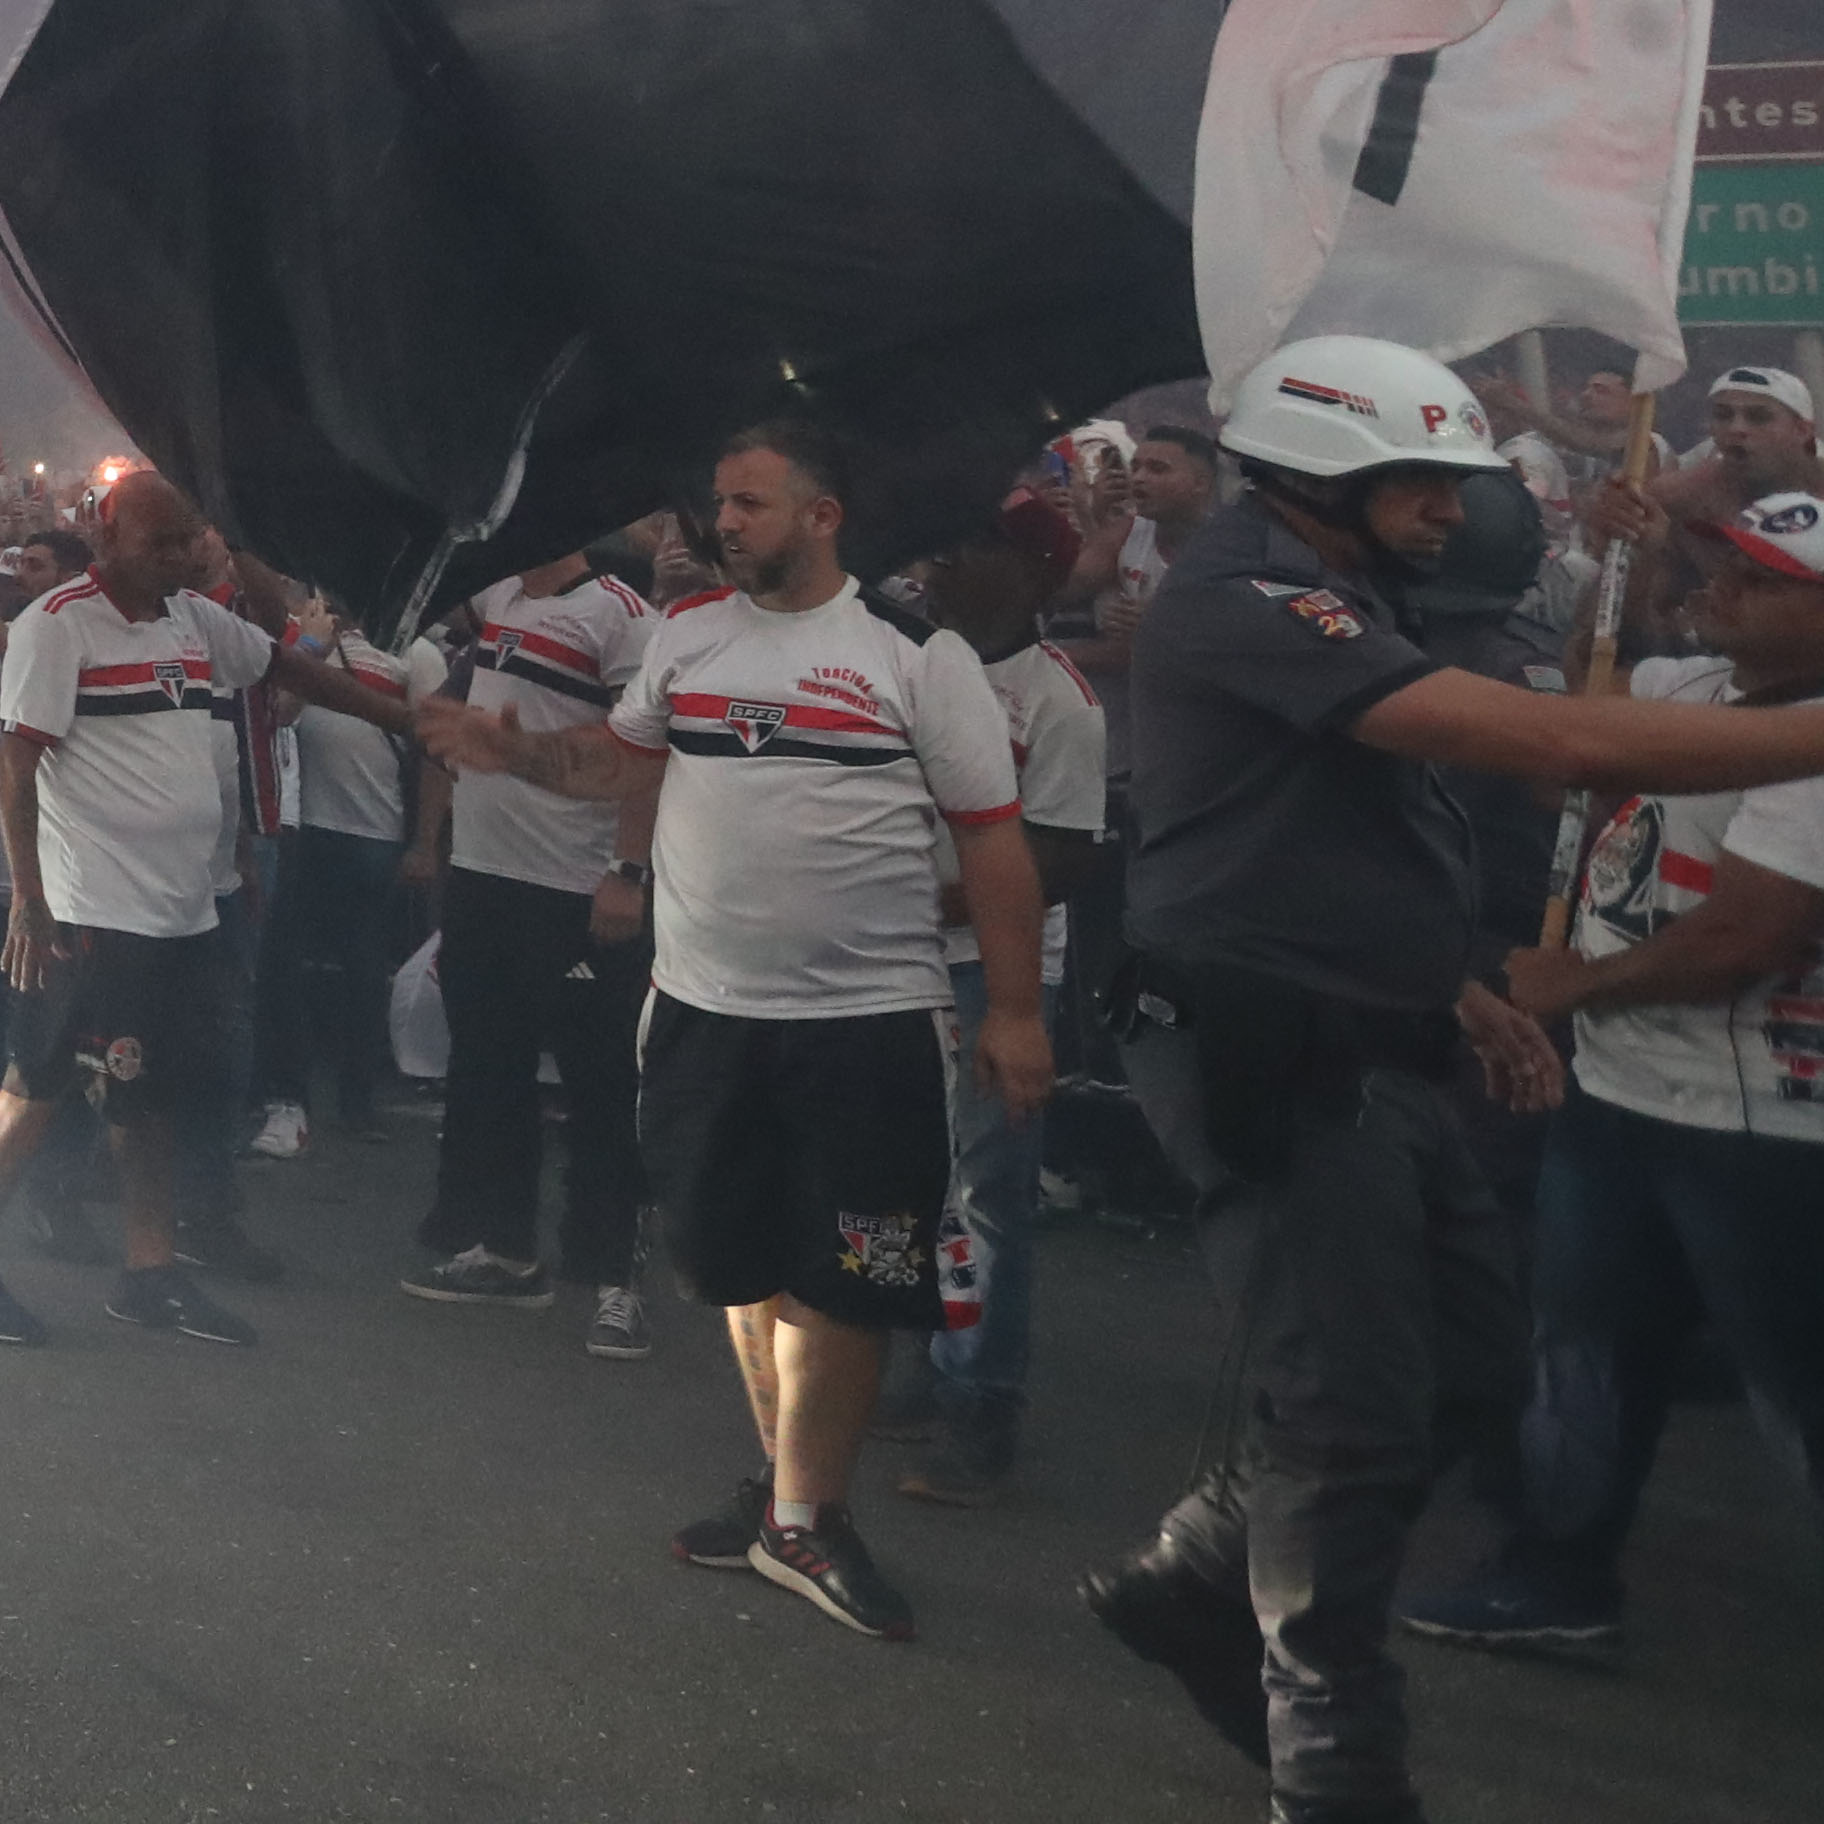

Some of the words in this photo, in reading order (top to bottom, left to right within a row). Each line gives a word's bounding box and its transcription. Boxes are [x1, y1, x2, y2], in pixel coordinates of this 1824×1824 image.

[1698, 95, 1820, 129] ntes
[1696, 201, 1810, 233] rno
[1679, 254, 1819, 296] umbi
[1419, 403, 1448, 433] P
[810, 666, 875, 695] TORCIDA
[796, 678, 881, 716] INDEPENDENTE
[731, 706, 782, 721] SPFC
[843, 1213, 881, 1233] SPF
